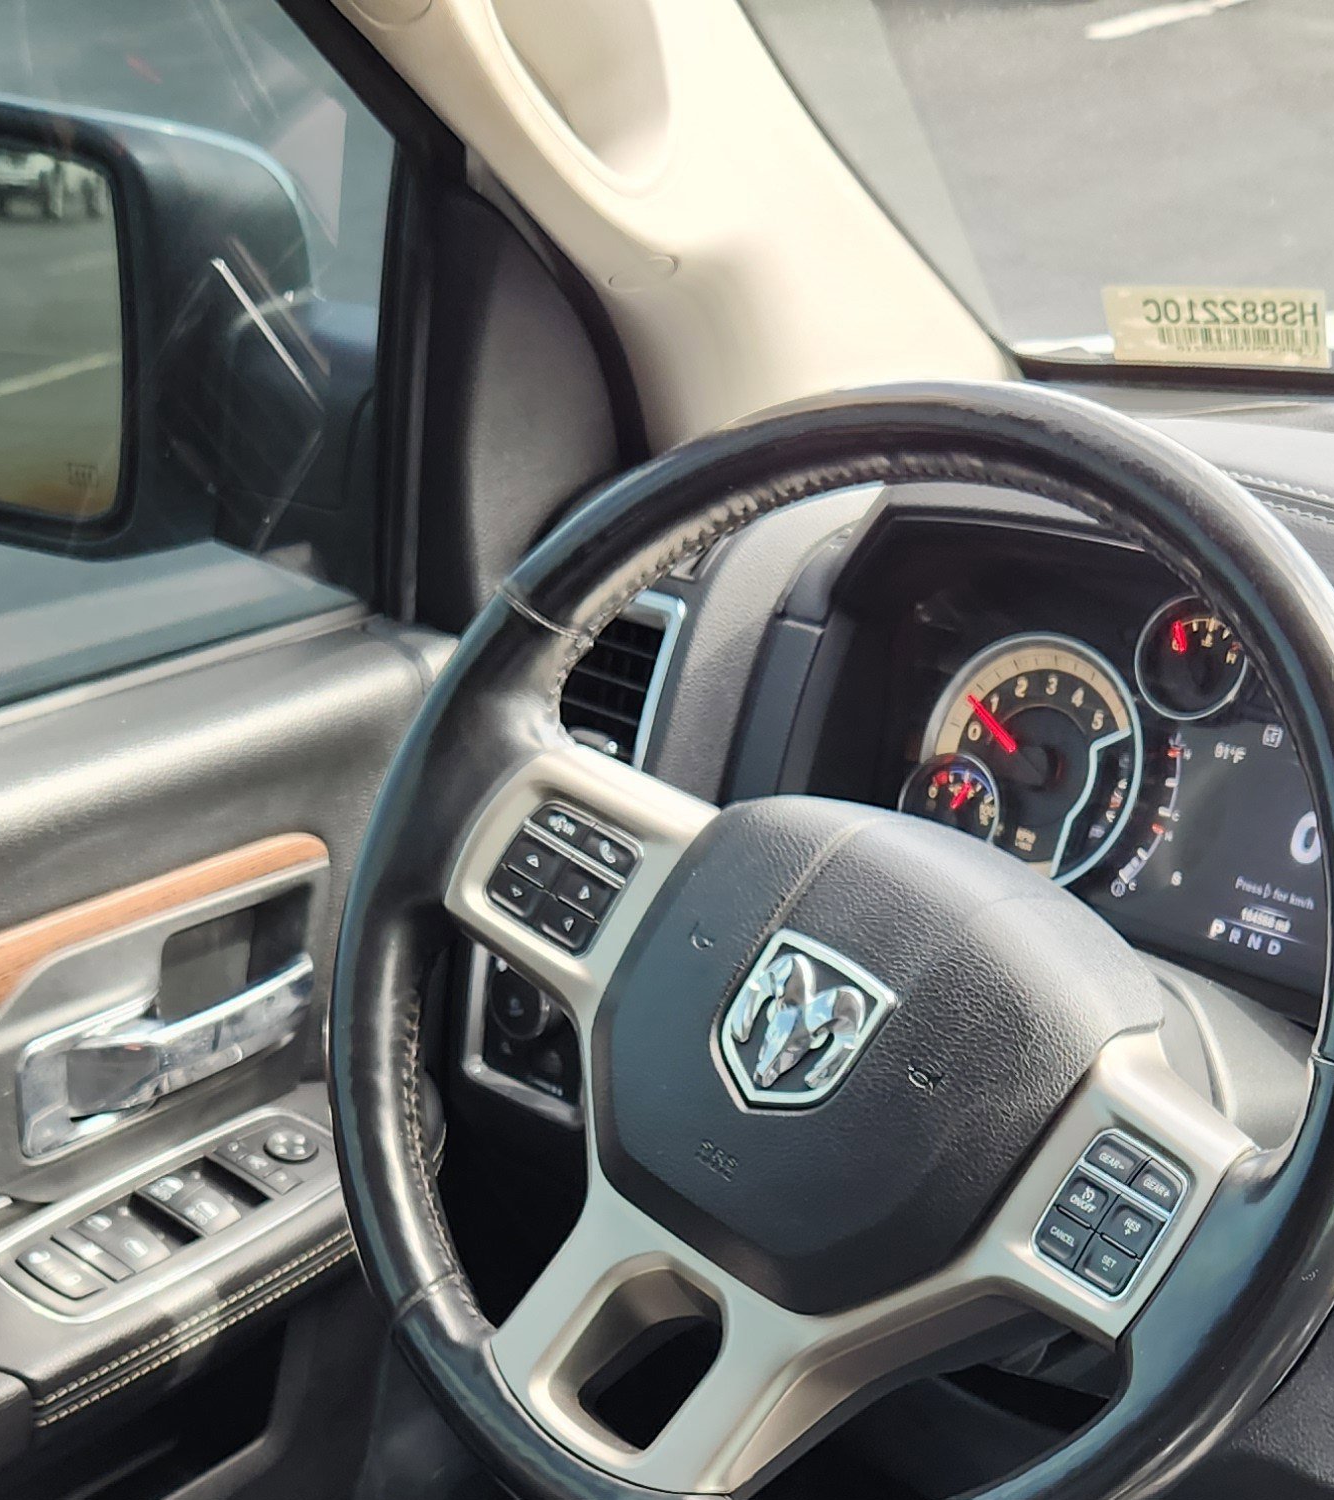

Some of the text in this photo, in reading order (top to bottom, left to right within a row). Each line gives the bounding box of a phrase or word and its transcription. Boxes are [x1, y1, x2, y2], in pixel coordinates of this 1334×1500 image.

[1014, 675, 1029, 698] 2
[1045, 674, 1059, 695] 3
[990, 692, 1000, 714] 1
[1071, 687, 1085, 708] 4
[1091, 708, 1105, 731] 5
[967, 720, 982, 741] 0
[1209, 918, 1282, 956] P R N D
[1123, 1216, 1142, 1233] RES
[1049, 1224, 1076, 1248] CANCEL
[1100, 1254, 1118, 1269] SET
